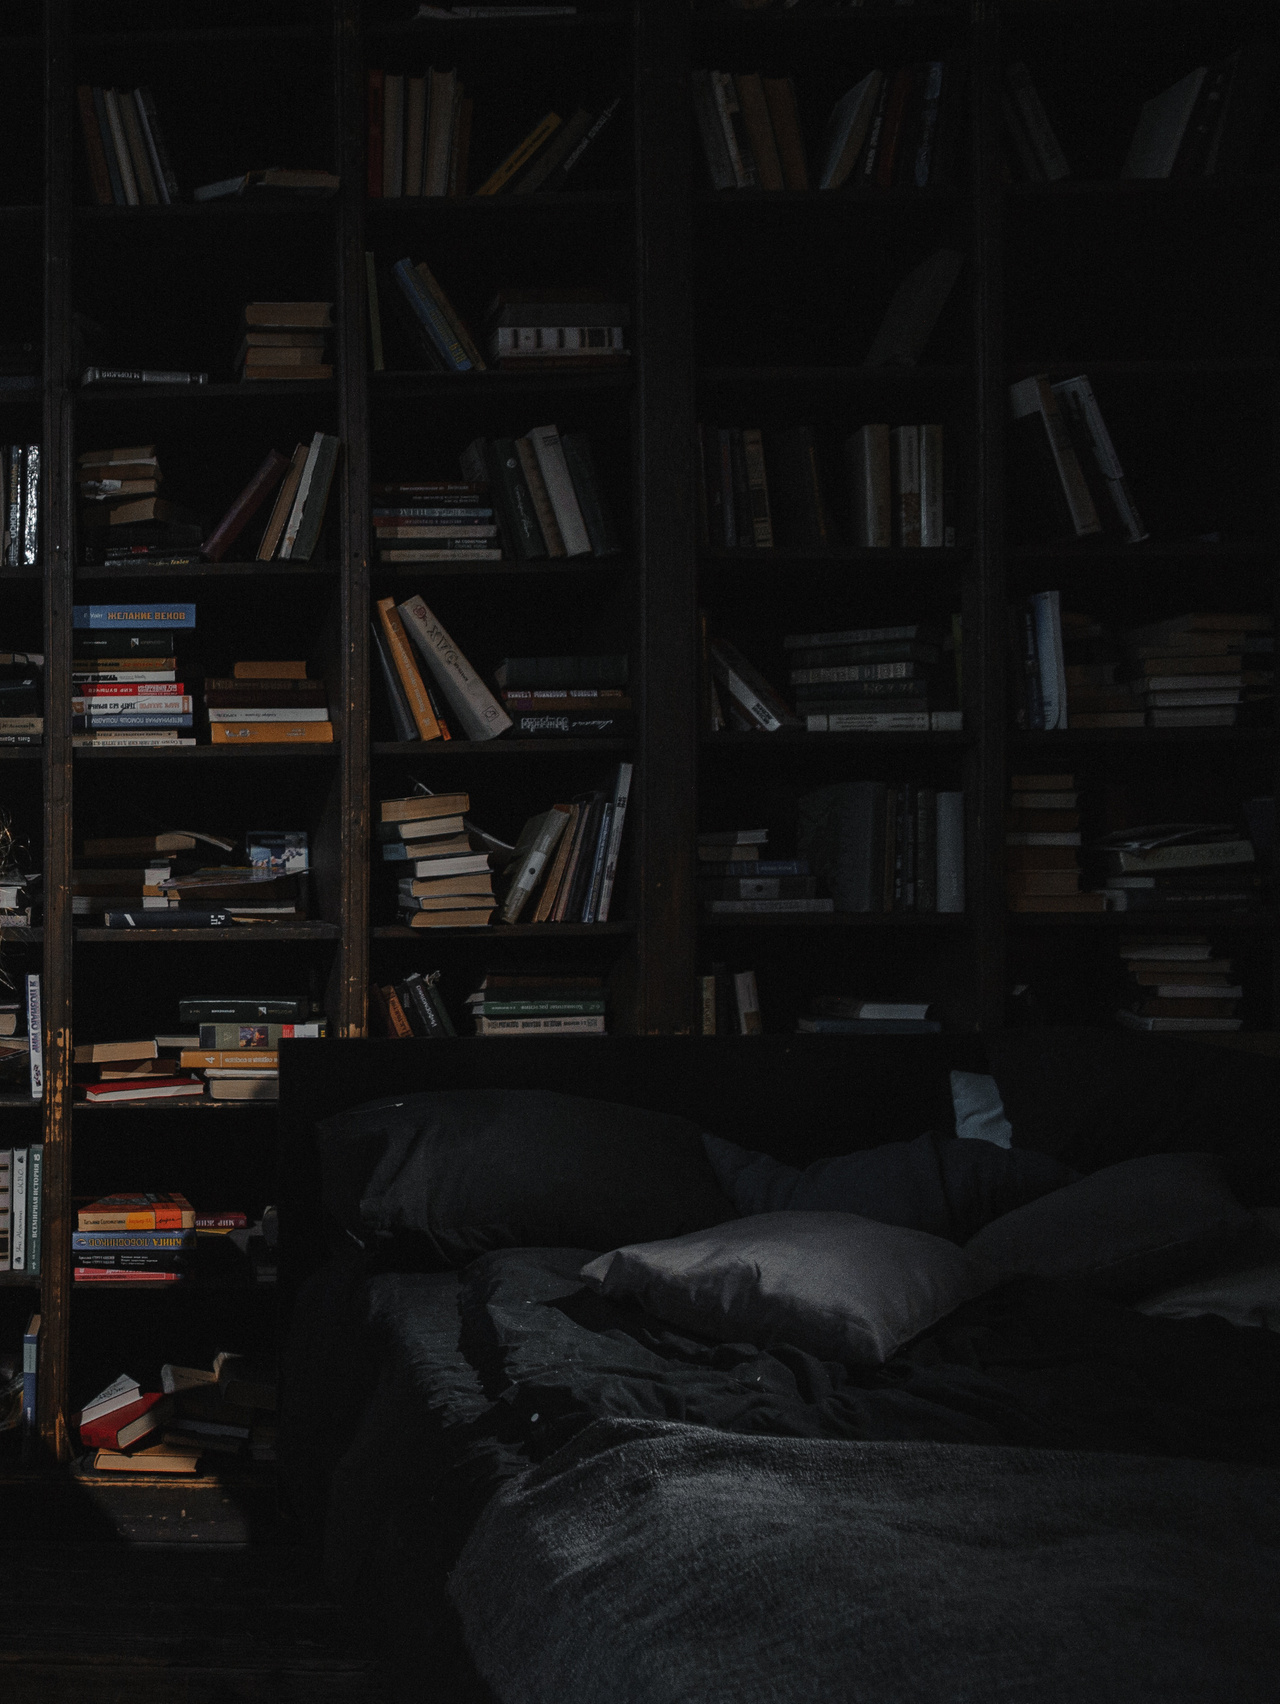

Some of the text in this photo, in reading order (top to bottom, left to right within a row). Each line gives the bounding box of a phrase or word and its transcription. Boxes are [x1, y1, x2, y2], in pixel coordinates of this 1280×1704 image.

[108, 612, 186, 620] ЖЕЛАНИЕ ВЕКОВ
[30, 989, 39, 1030] ПОЗНАЮ
[32, 1032, 40, 1053] МИР
[89, 1238, 182, 1247] КНИГА ЛЮБОВНИКОВ
